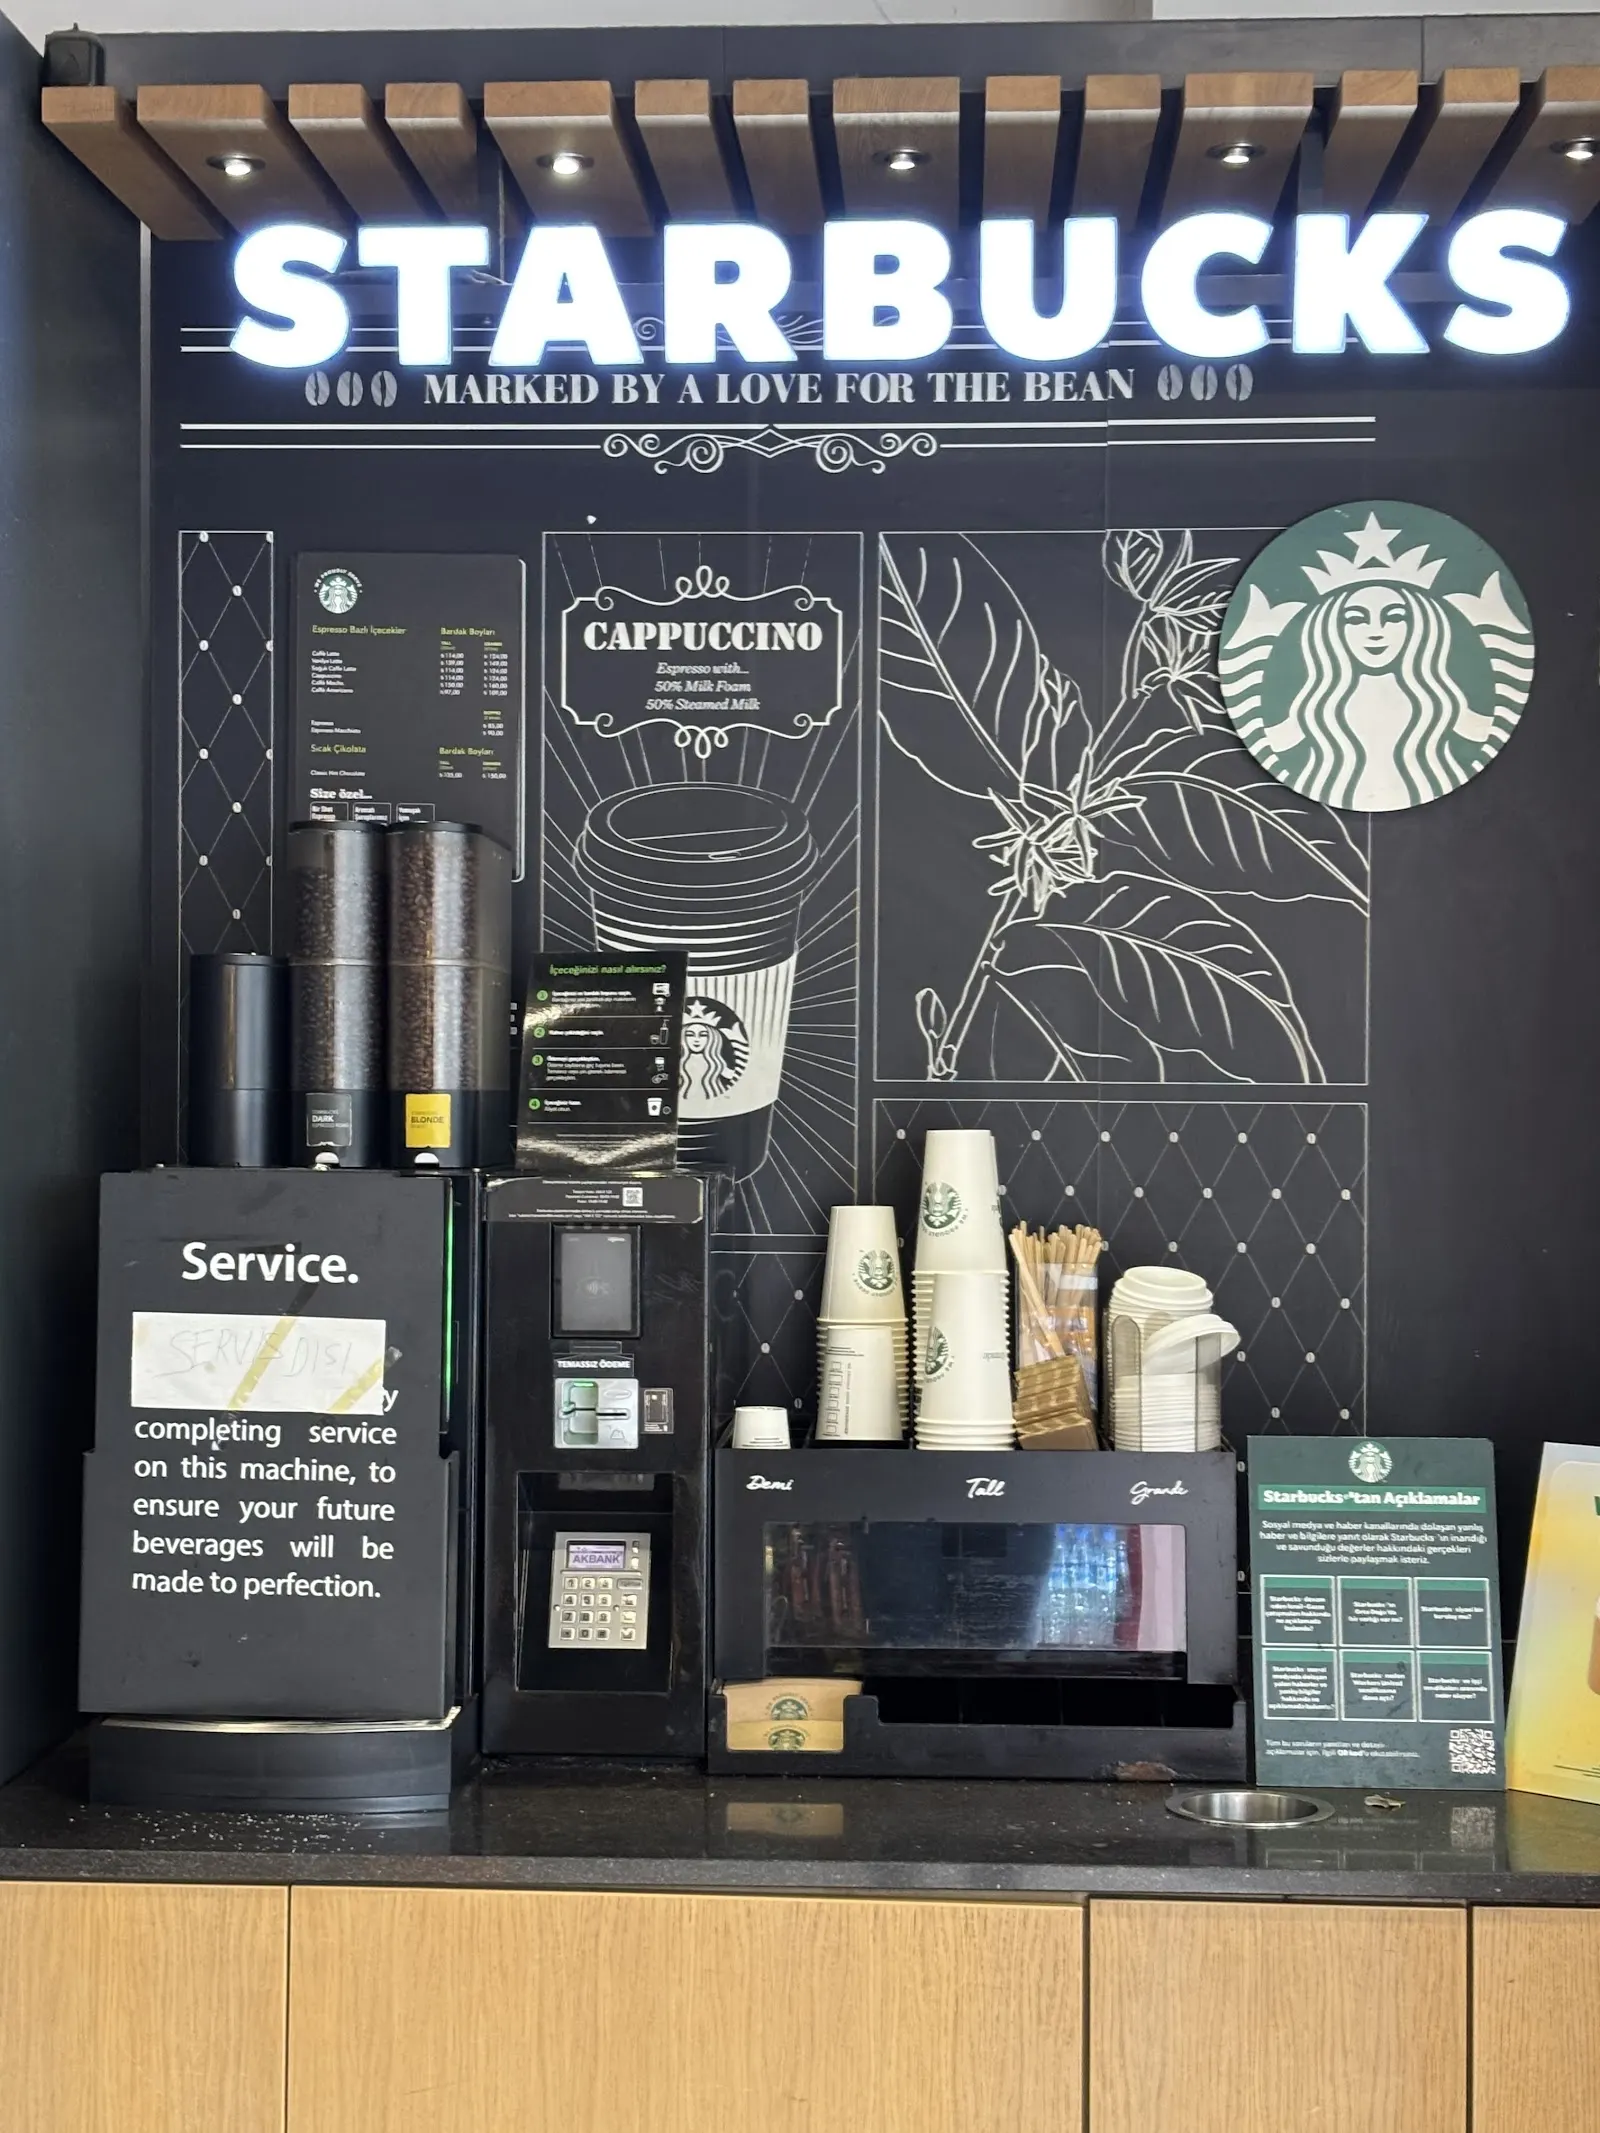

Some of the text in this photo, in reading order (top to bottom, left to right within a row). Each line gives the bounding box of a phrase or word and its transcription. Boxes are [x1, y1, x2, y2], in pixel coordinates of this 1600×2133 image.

[229, 208, 1570, 368] STARBUCKS
[424, 368, 1136, 406] MARKED BY A LOVE FOR THE BEAN
[312, 625, 347, 635] Espresso
[440, 627, 467, 635] Bardak
[584, 622, 823, 650] CAPPUCCINO
[656, 662, 711, 676] Espresso
[654, 681, 751, 693] 50% Milk Foam
[645, 698, 760, 711] 50% Steamed Milk
[439, 747, 466, 755] Bardak
[310, 788, 336, 799] Size
[601, 965, 623, 974] nasıl
[312, 1115, 335, 1123] DARK
[411, 1116, 445, 1124] BLONDE
[181, 1241, 359, 1284] Service.
[557, 1359, 631, 1369] TEMASSIZ ÖDEME
[135, 1417, 397, 1448] completing service
[134, 1456, 396, 1485] on this machine, to
[746, 1475, 794, 1492] Demi
[966, 1477, 1006, 1499] Tall
[1129, 1480, 1189, 1505] Grande
[1384, 1491, 1480, 1508] Açıklamalar
[133, 1496, 395, 1523] ensure your future
[1262, 1520, 1290, 1530] Sosyal
[1292, 1521, 1323, 1531] medya
[1336, 1521, 1362, 1529] haber
[1259, 1531, 1285, 1540] haber
[133, 1530, 394, 1562] beverages will be
[572, 1554, 621, 1564] AKBANK
[132, 1570, 381, 1600] made to perfection.
